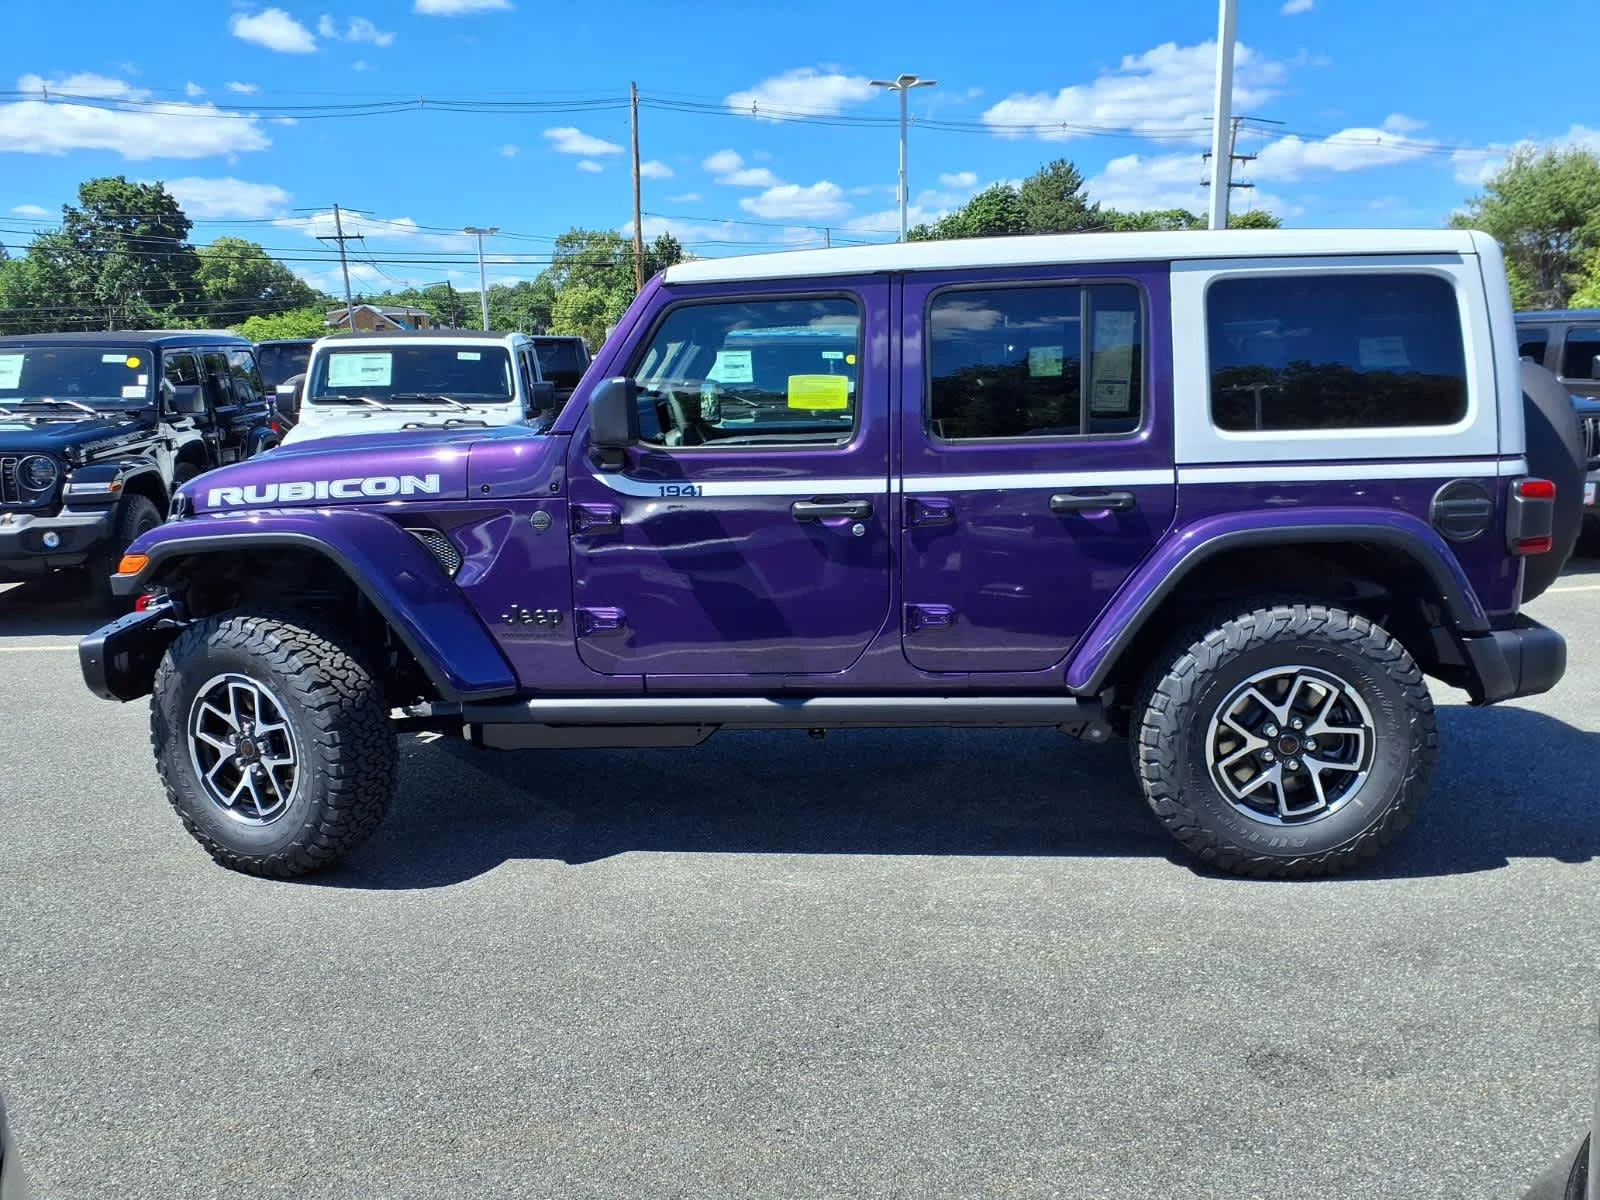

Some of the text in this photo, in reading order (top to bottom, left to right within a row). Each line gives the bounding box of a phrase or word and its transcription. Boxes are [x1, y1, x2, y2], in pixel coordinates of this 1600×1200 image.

[207, 474, 440, 507] RUBICON
[658, 485, 703, 497] 1941
[501, 604, 564, 628] Jeep
